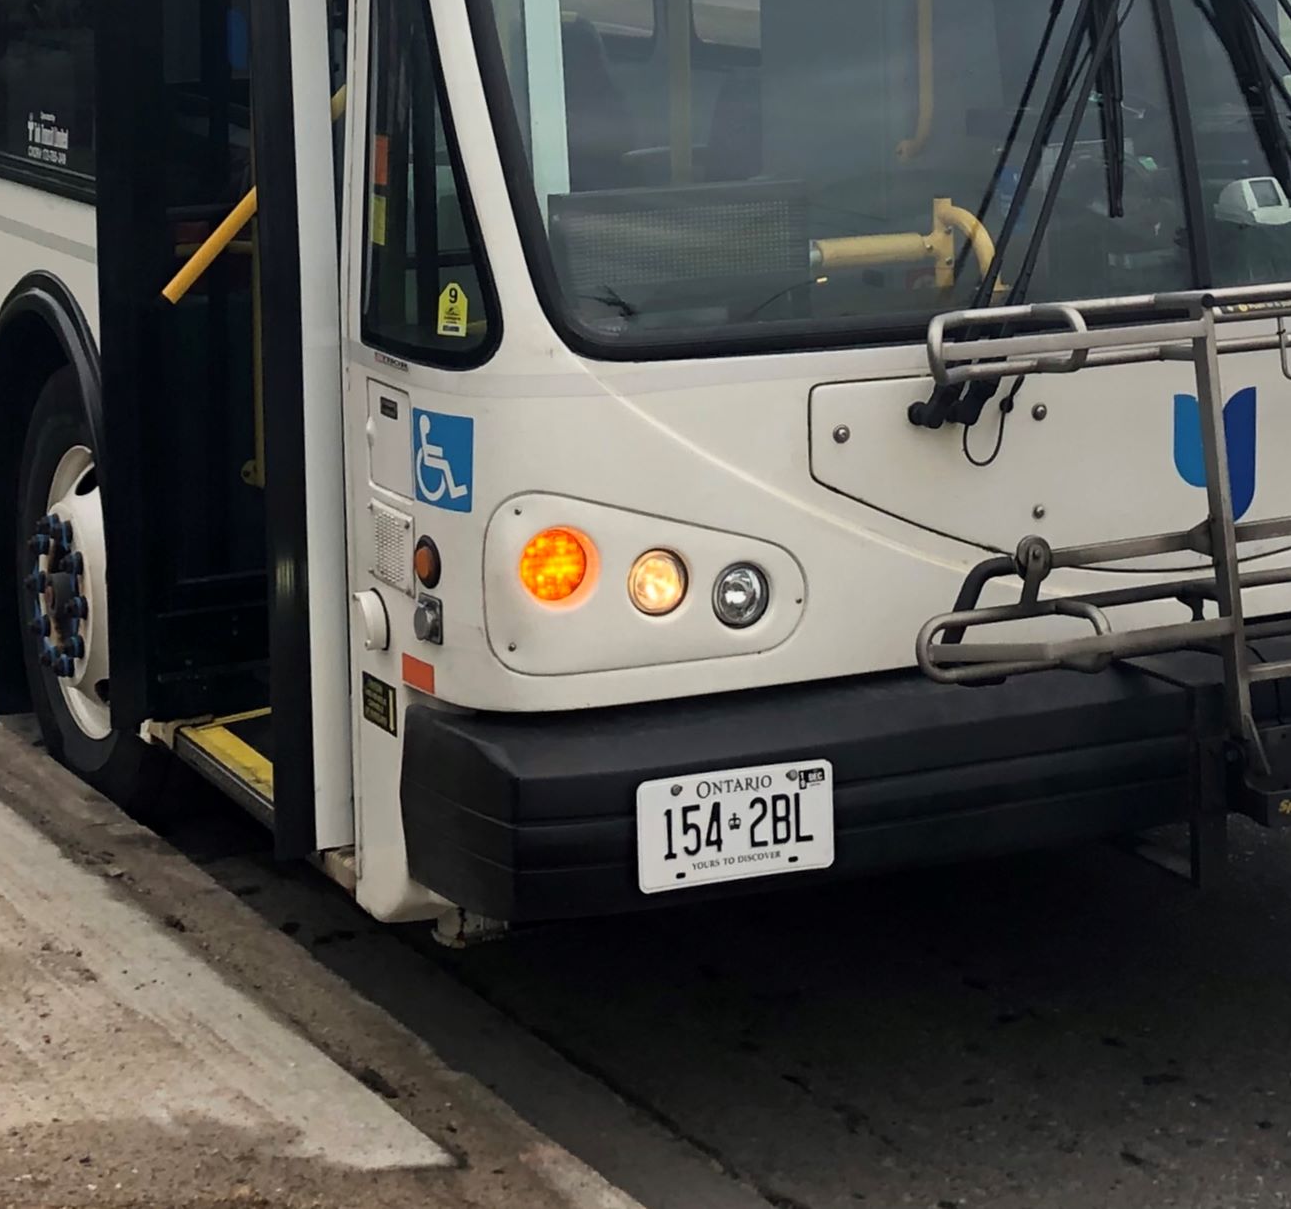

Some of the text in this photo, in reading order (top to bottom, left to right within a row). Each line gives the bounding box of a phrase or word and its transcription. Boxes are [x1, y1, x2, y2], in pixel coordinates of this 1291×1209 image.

[448, 287, 458, 304] 9
[696, 774, 772, 800] ONTARIO
[664, 792, 814, 861] 154 2BL
[692, 850, 782, 871] YOURS TO DISCOVER
